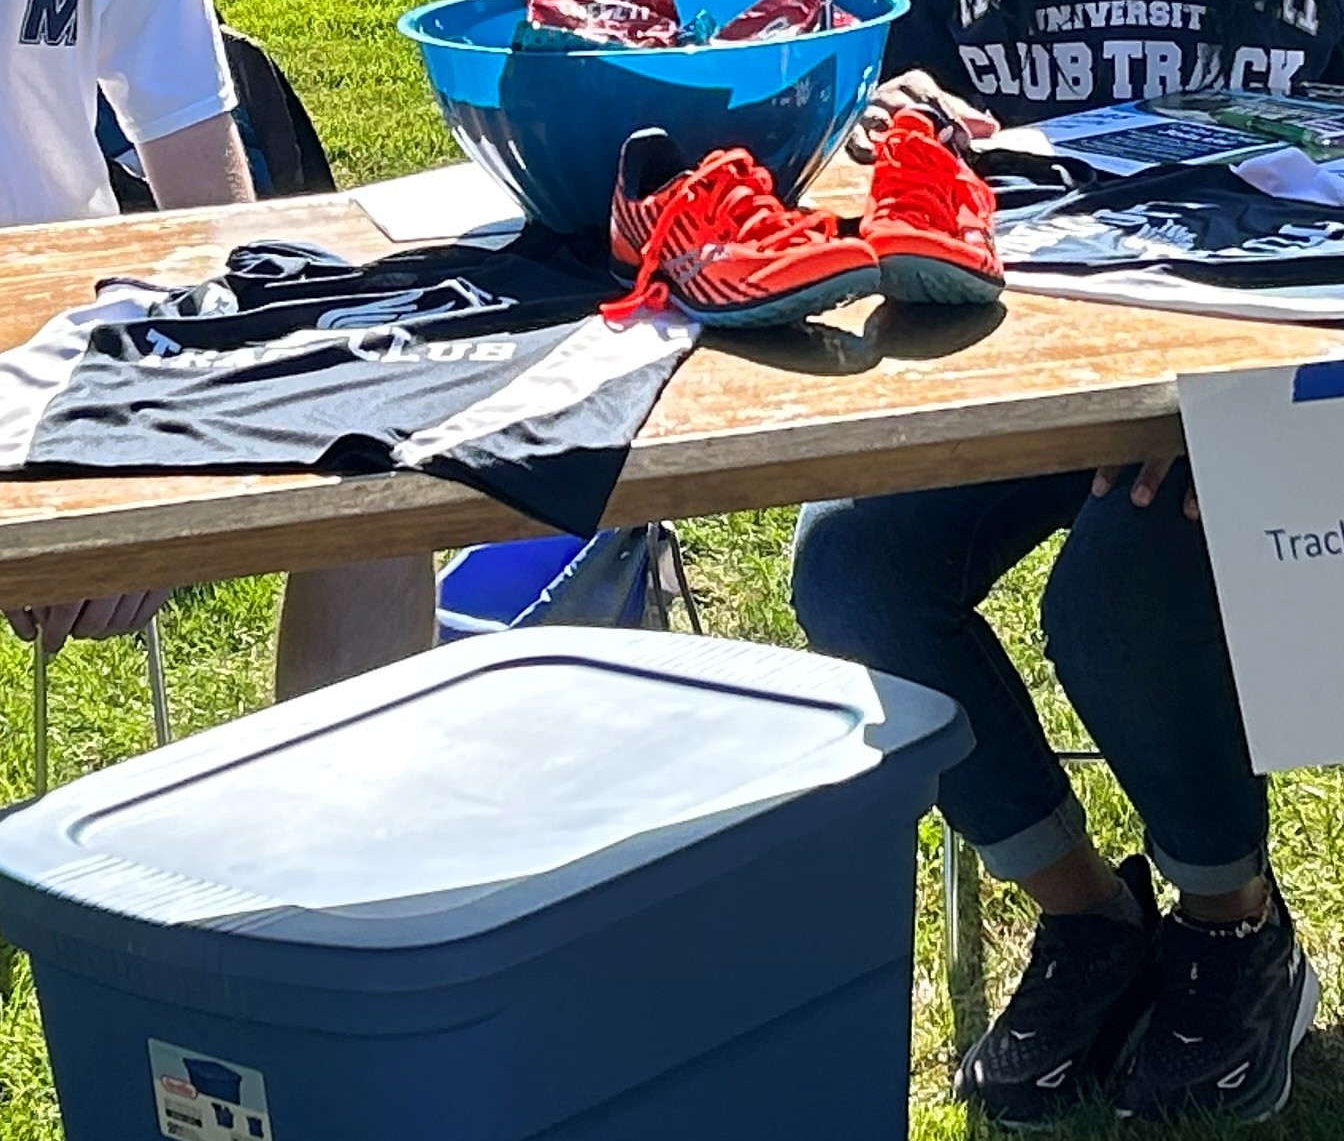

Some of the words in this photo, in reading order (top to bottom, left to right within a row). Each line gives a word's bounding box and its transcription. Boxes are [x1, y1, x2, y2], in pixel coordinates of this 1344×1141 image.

[1030, 0, 1208, 36] UNIVERSIT
[959, 41, 1094, 101] CLUB
[1103, 40, 1306, 100] TRACK
